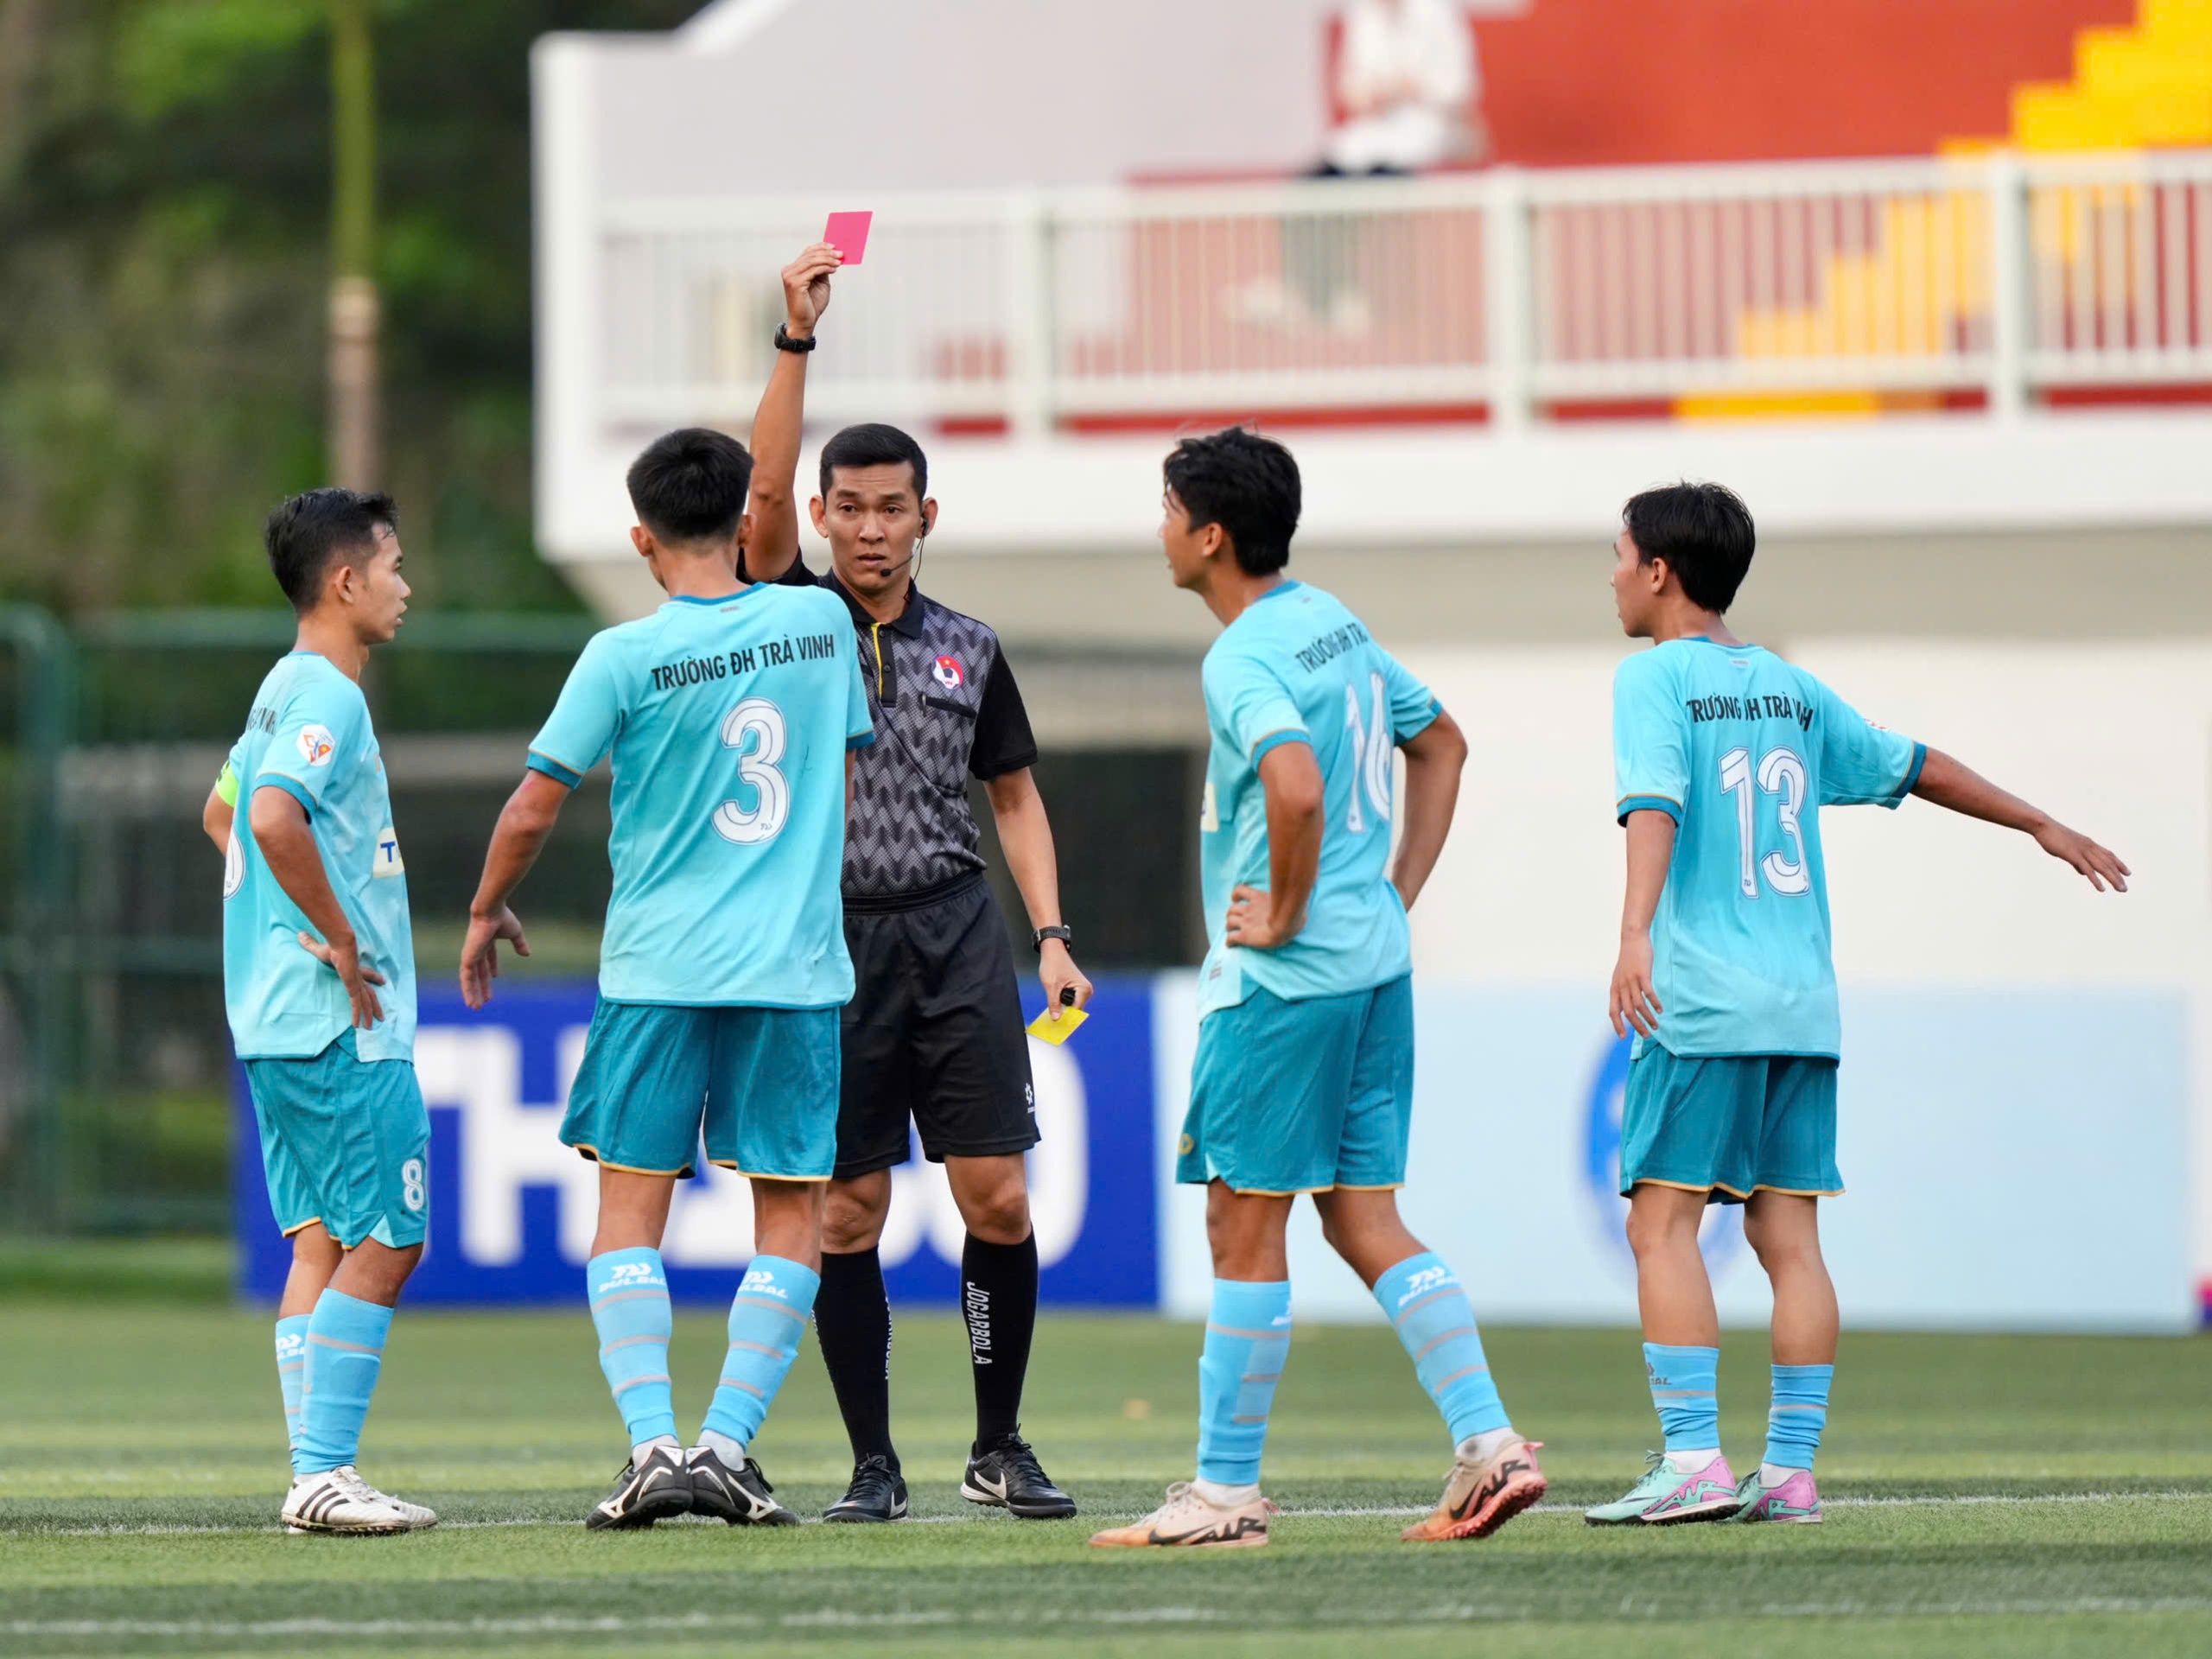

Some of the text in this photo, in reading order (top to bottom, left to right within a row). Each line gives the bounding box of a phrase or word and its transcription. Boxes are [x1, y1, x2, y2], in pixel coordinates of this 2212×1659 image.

[652, 634, 835, 690] TRƯỜNG ĐH TRÀ VINH
[1763, 691, 1793, 719] TRÀ
[711, 696, 790, 846] 3
[1717, 745, 1811, 899] 13
[402, 1158, 424, 1211] 8
[966, 1281, 993, 1364] JOGARBOLA
